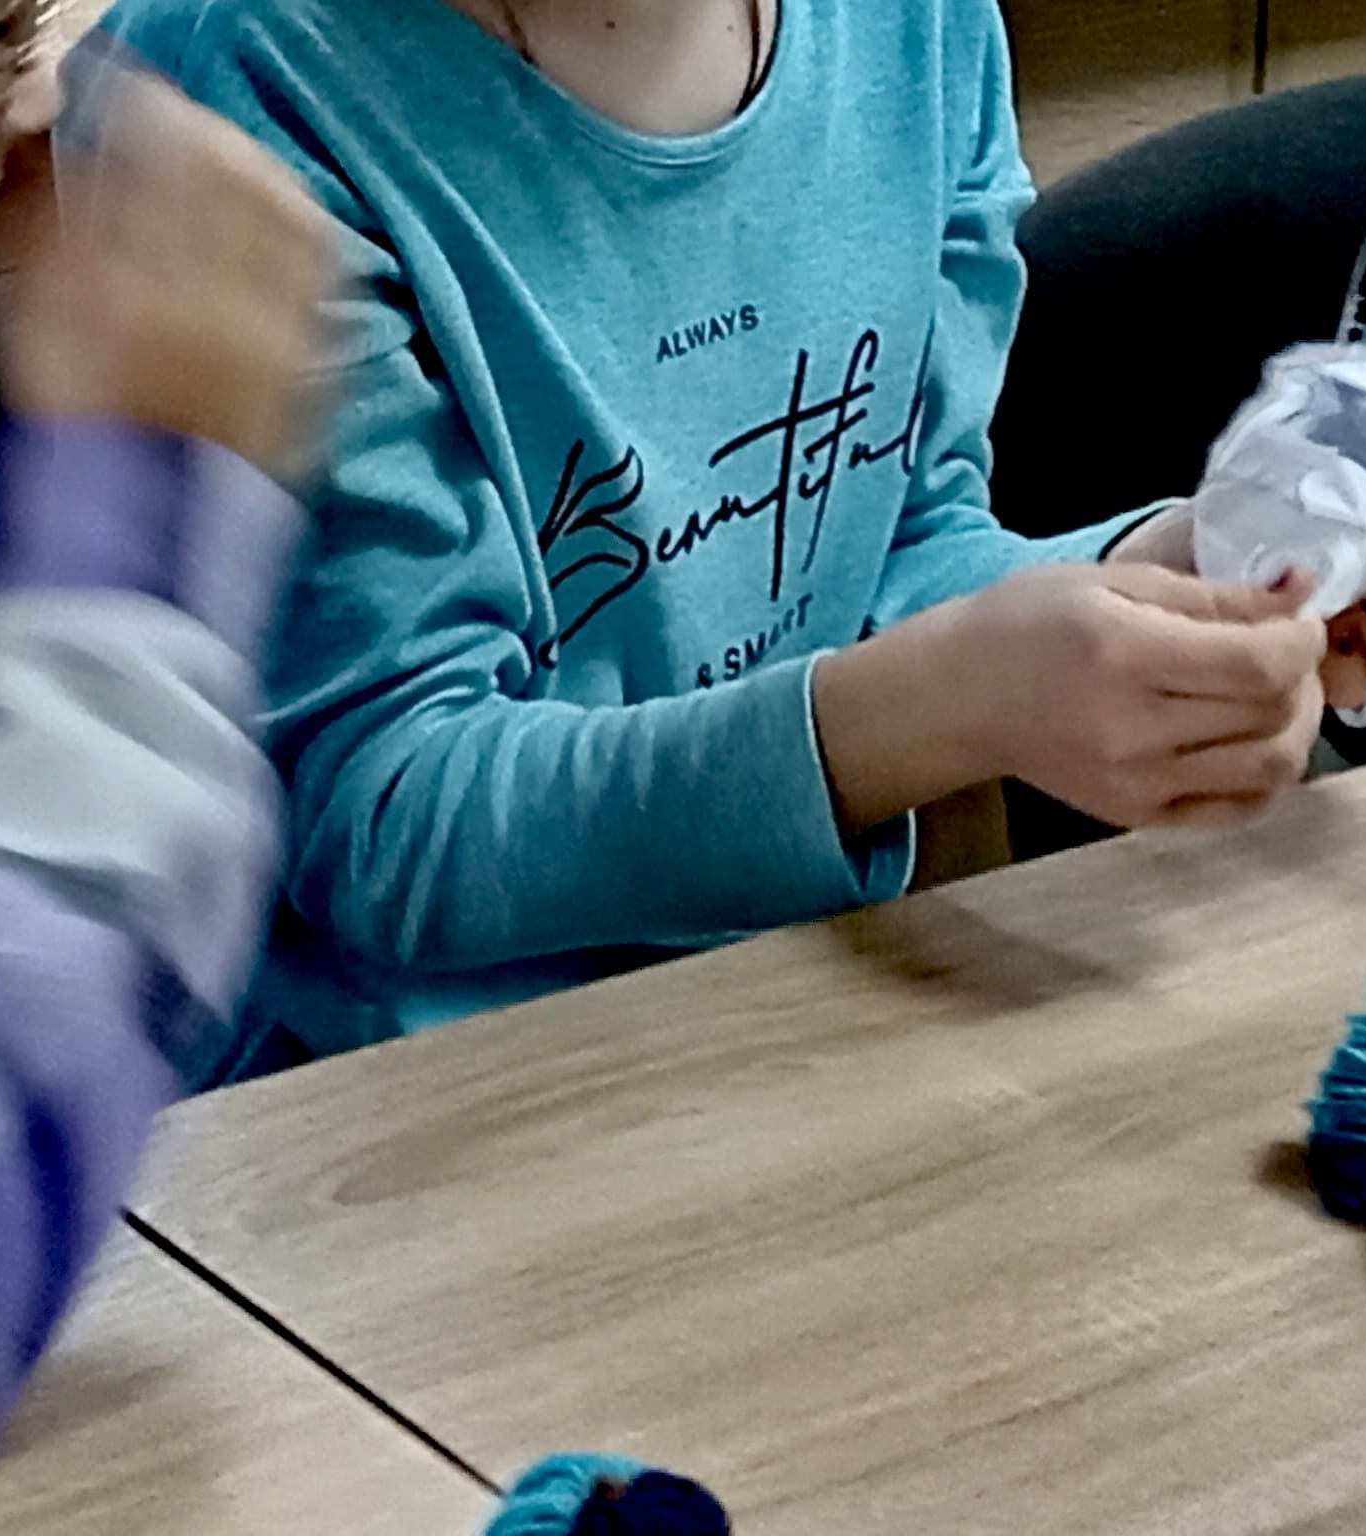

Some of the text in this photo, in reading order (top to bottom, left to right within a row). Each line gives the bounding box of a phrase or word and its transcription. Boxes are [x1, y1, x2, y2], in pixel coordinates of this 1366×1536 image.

[656, 304, 759, 363] ALWAYS
[538, 312, 935, 670] Beautiful
[696, 662, 714, 689] &
